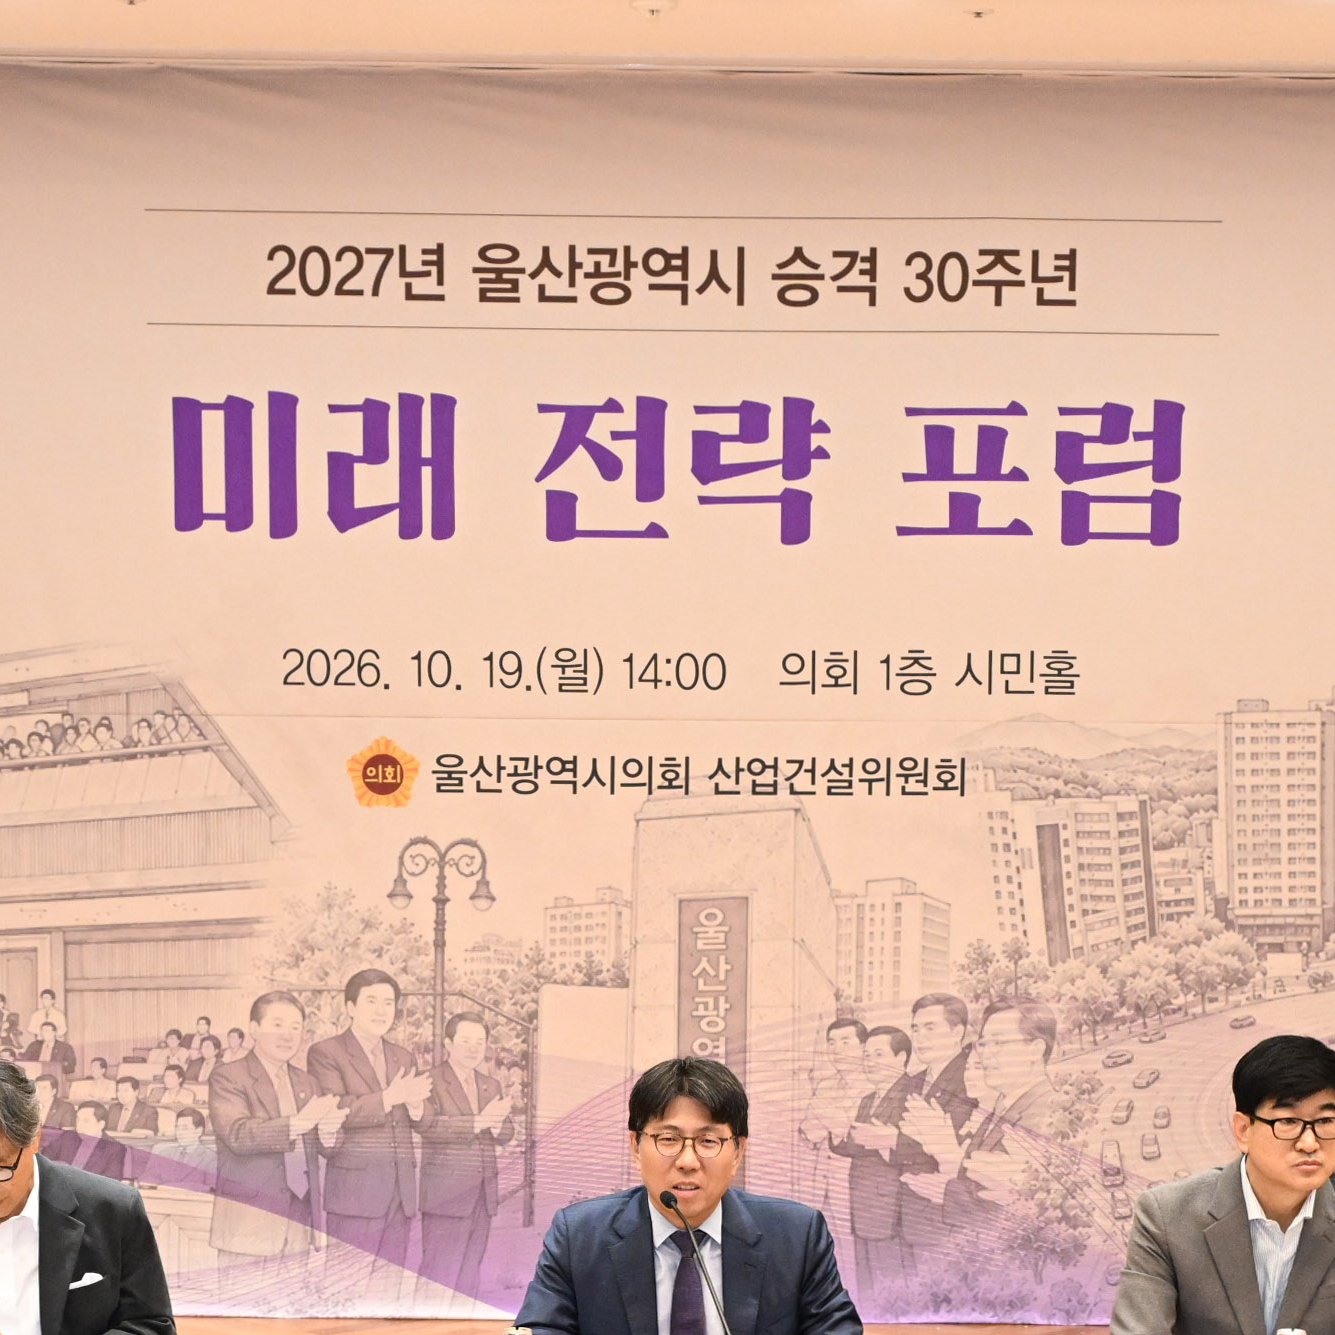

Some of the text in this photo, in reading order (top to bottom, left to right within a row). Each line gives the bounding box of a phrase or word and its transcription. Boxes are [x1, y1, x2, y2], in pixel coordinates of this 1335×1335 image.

[266, 243, 1079, 308] 2027년 울산광역시 승격 30주년
[171, 390, 1186, 547] 미래 전략 포럼
[282, 649, 390, 690] 2026.
[410, 652, 462, 690] 10.
[622, 651, 726, 692] 14:00
[780, 649, 859, 696] 의회
[881, 649, 936, 696] 1층
[954, 649, 1081, 697] 시민홀
[363, 764, 401, 787] 의회
[432, 751, 968, 799] 울산광역시의회 산업건설위원회
